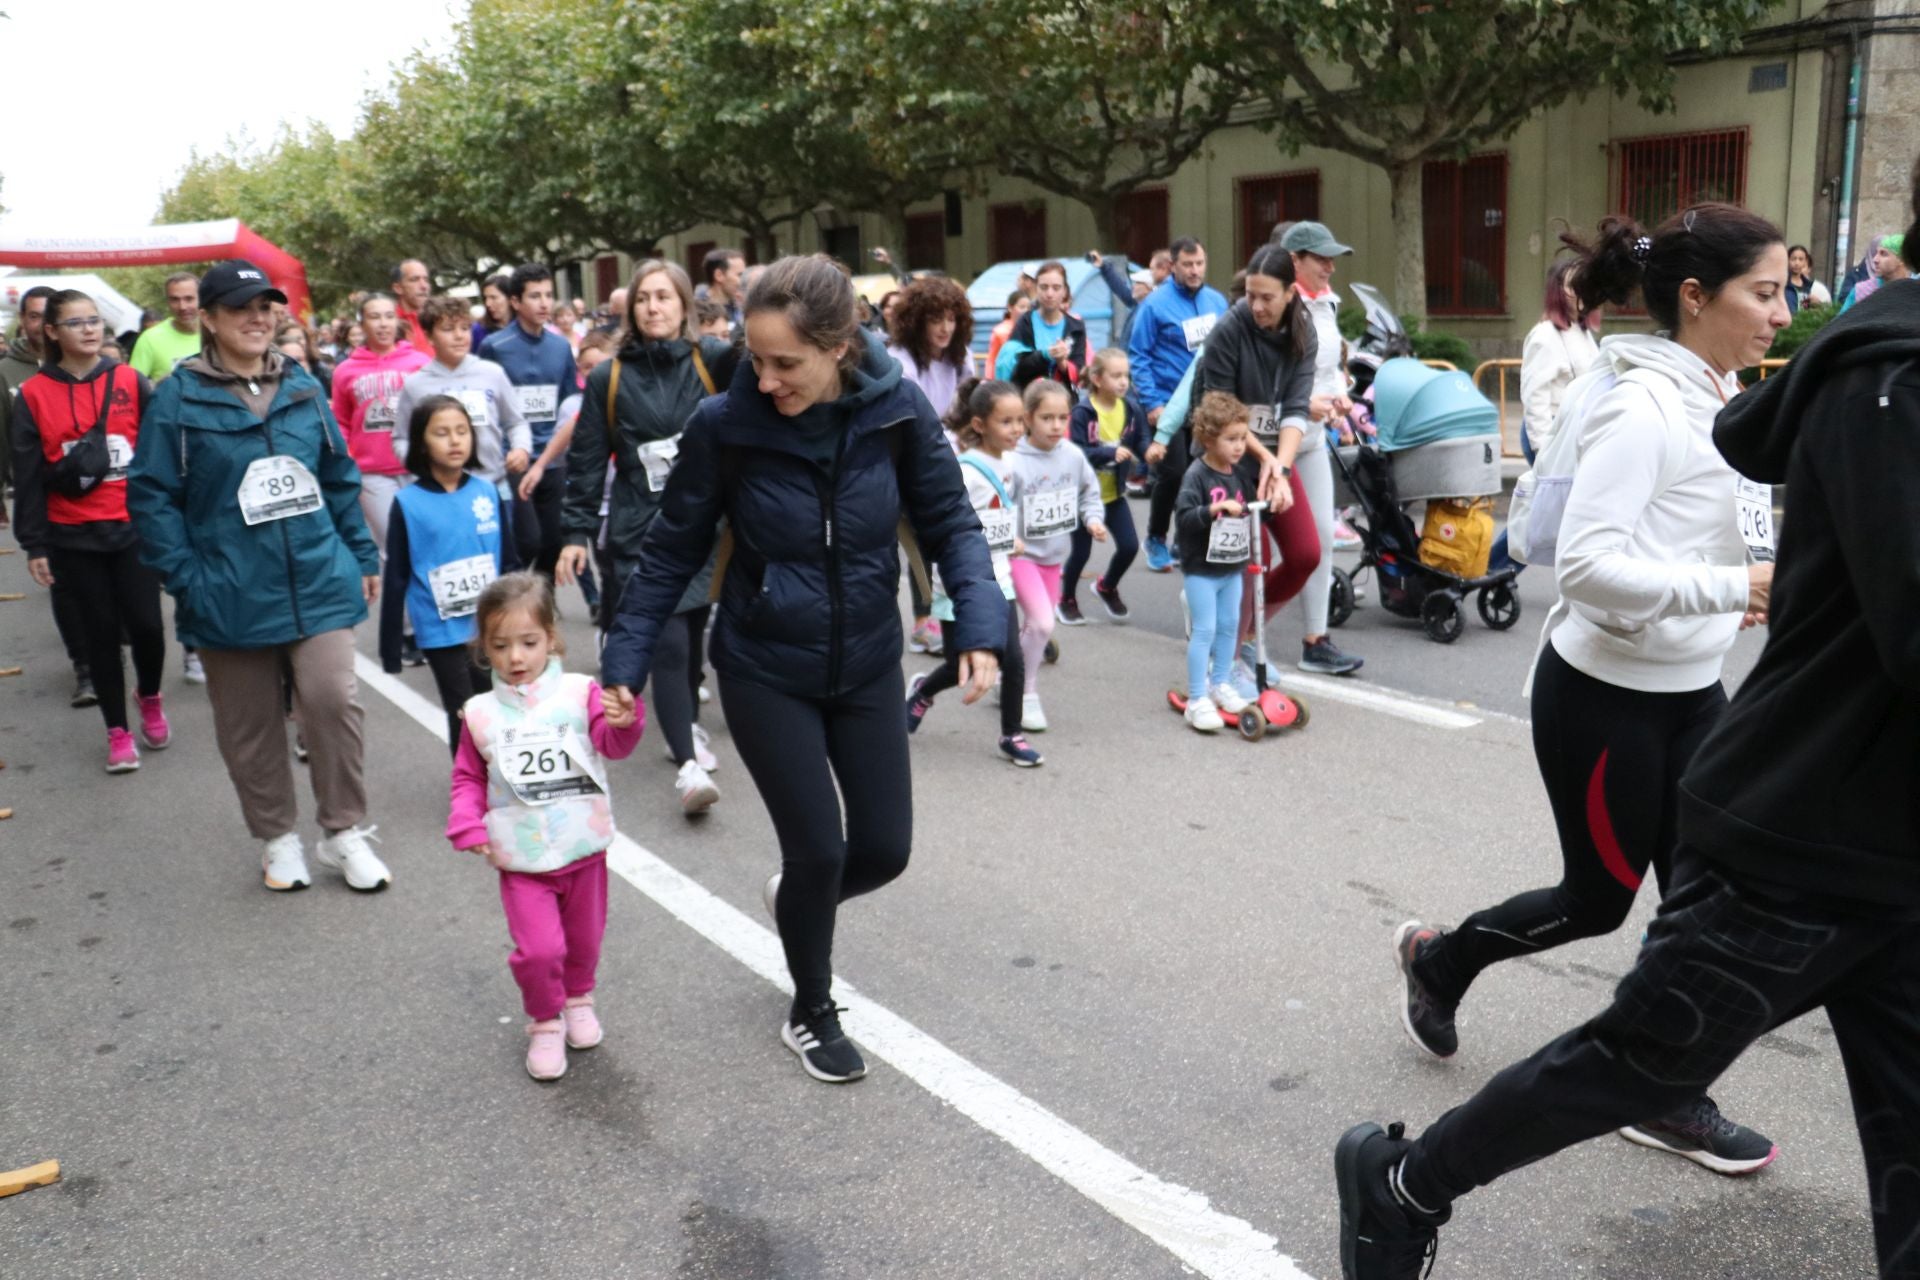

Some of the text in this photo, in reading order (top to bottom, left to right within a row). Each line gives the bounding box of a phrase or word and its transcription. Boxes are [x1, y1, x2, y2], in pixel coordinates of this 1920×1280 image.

[524, 398, 546, 409] 506
[1035, 503, 1070, 523] 2415
[445, 573, 487, 598] 2481
[518, 748, 571, 776] 261
